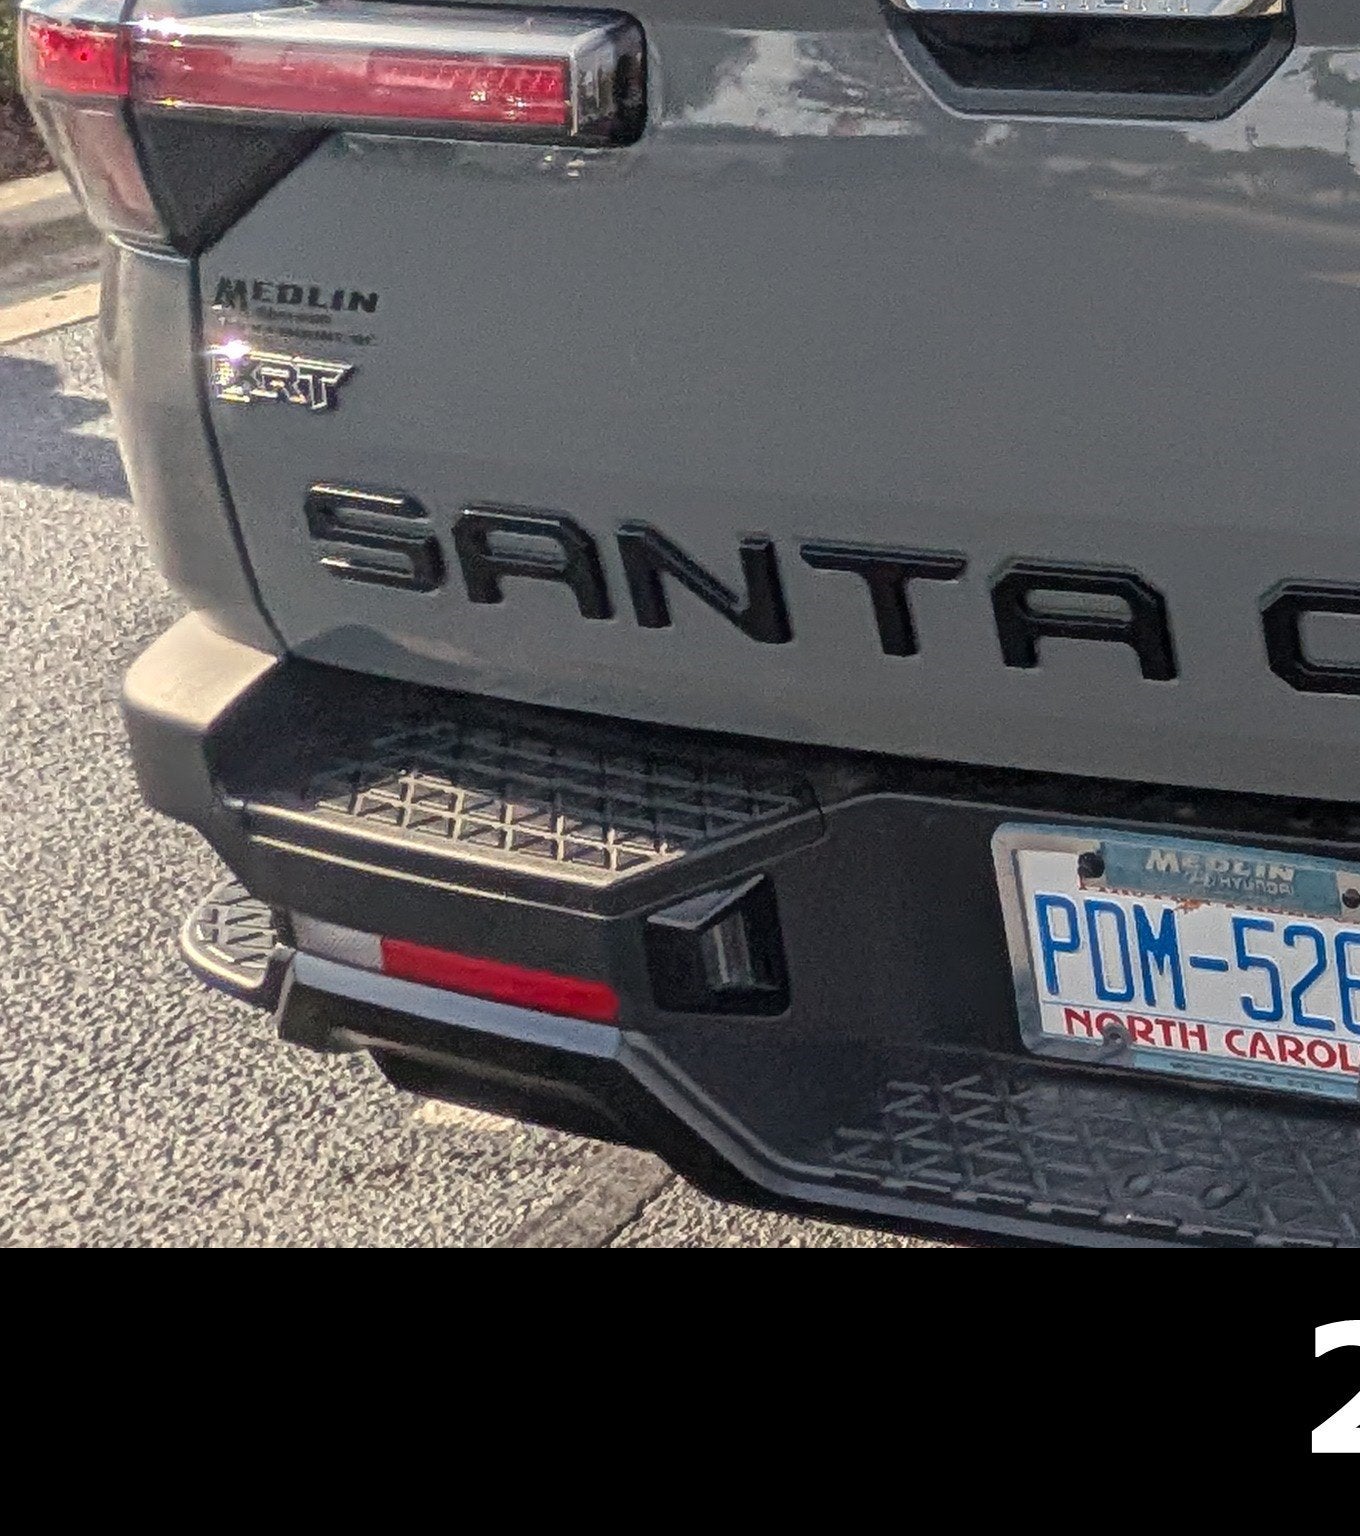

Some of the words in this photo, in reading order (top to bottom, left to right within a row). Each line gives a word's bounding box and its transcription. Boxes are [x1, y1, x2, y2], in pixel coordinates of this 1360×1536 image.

[212, 276, 380, 313] MEDLIN
[303, 481, 1181, 683] SANTA
[1145, 847, 1296, 883] MEDLIN
[1063, 1007, 1208, 1052] NORTH
